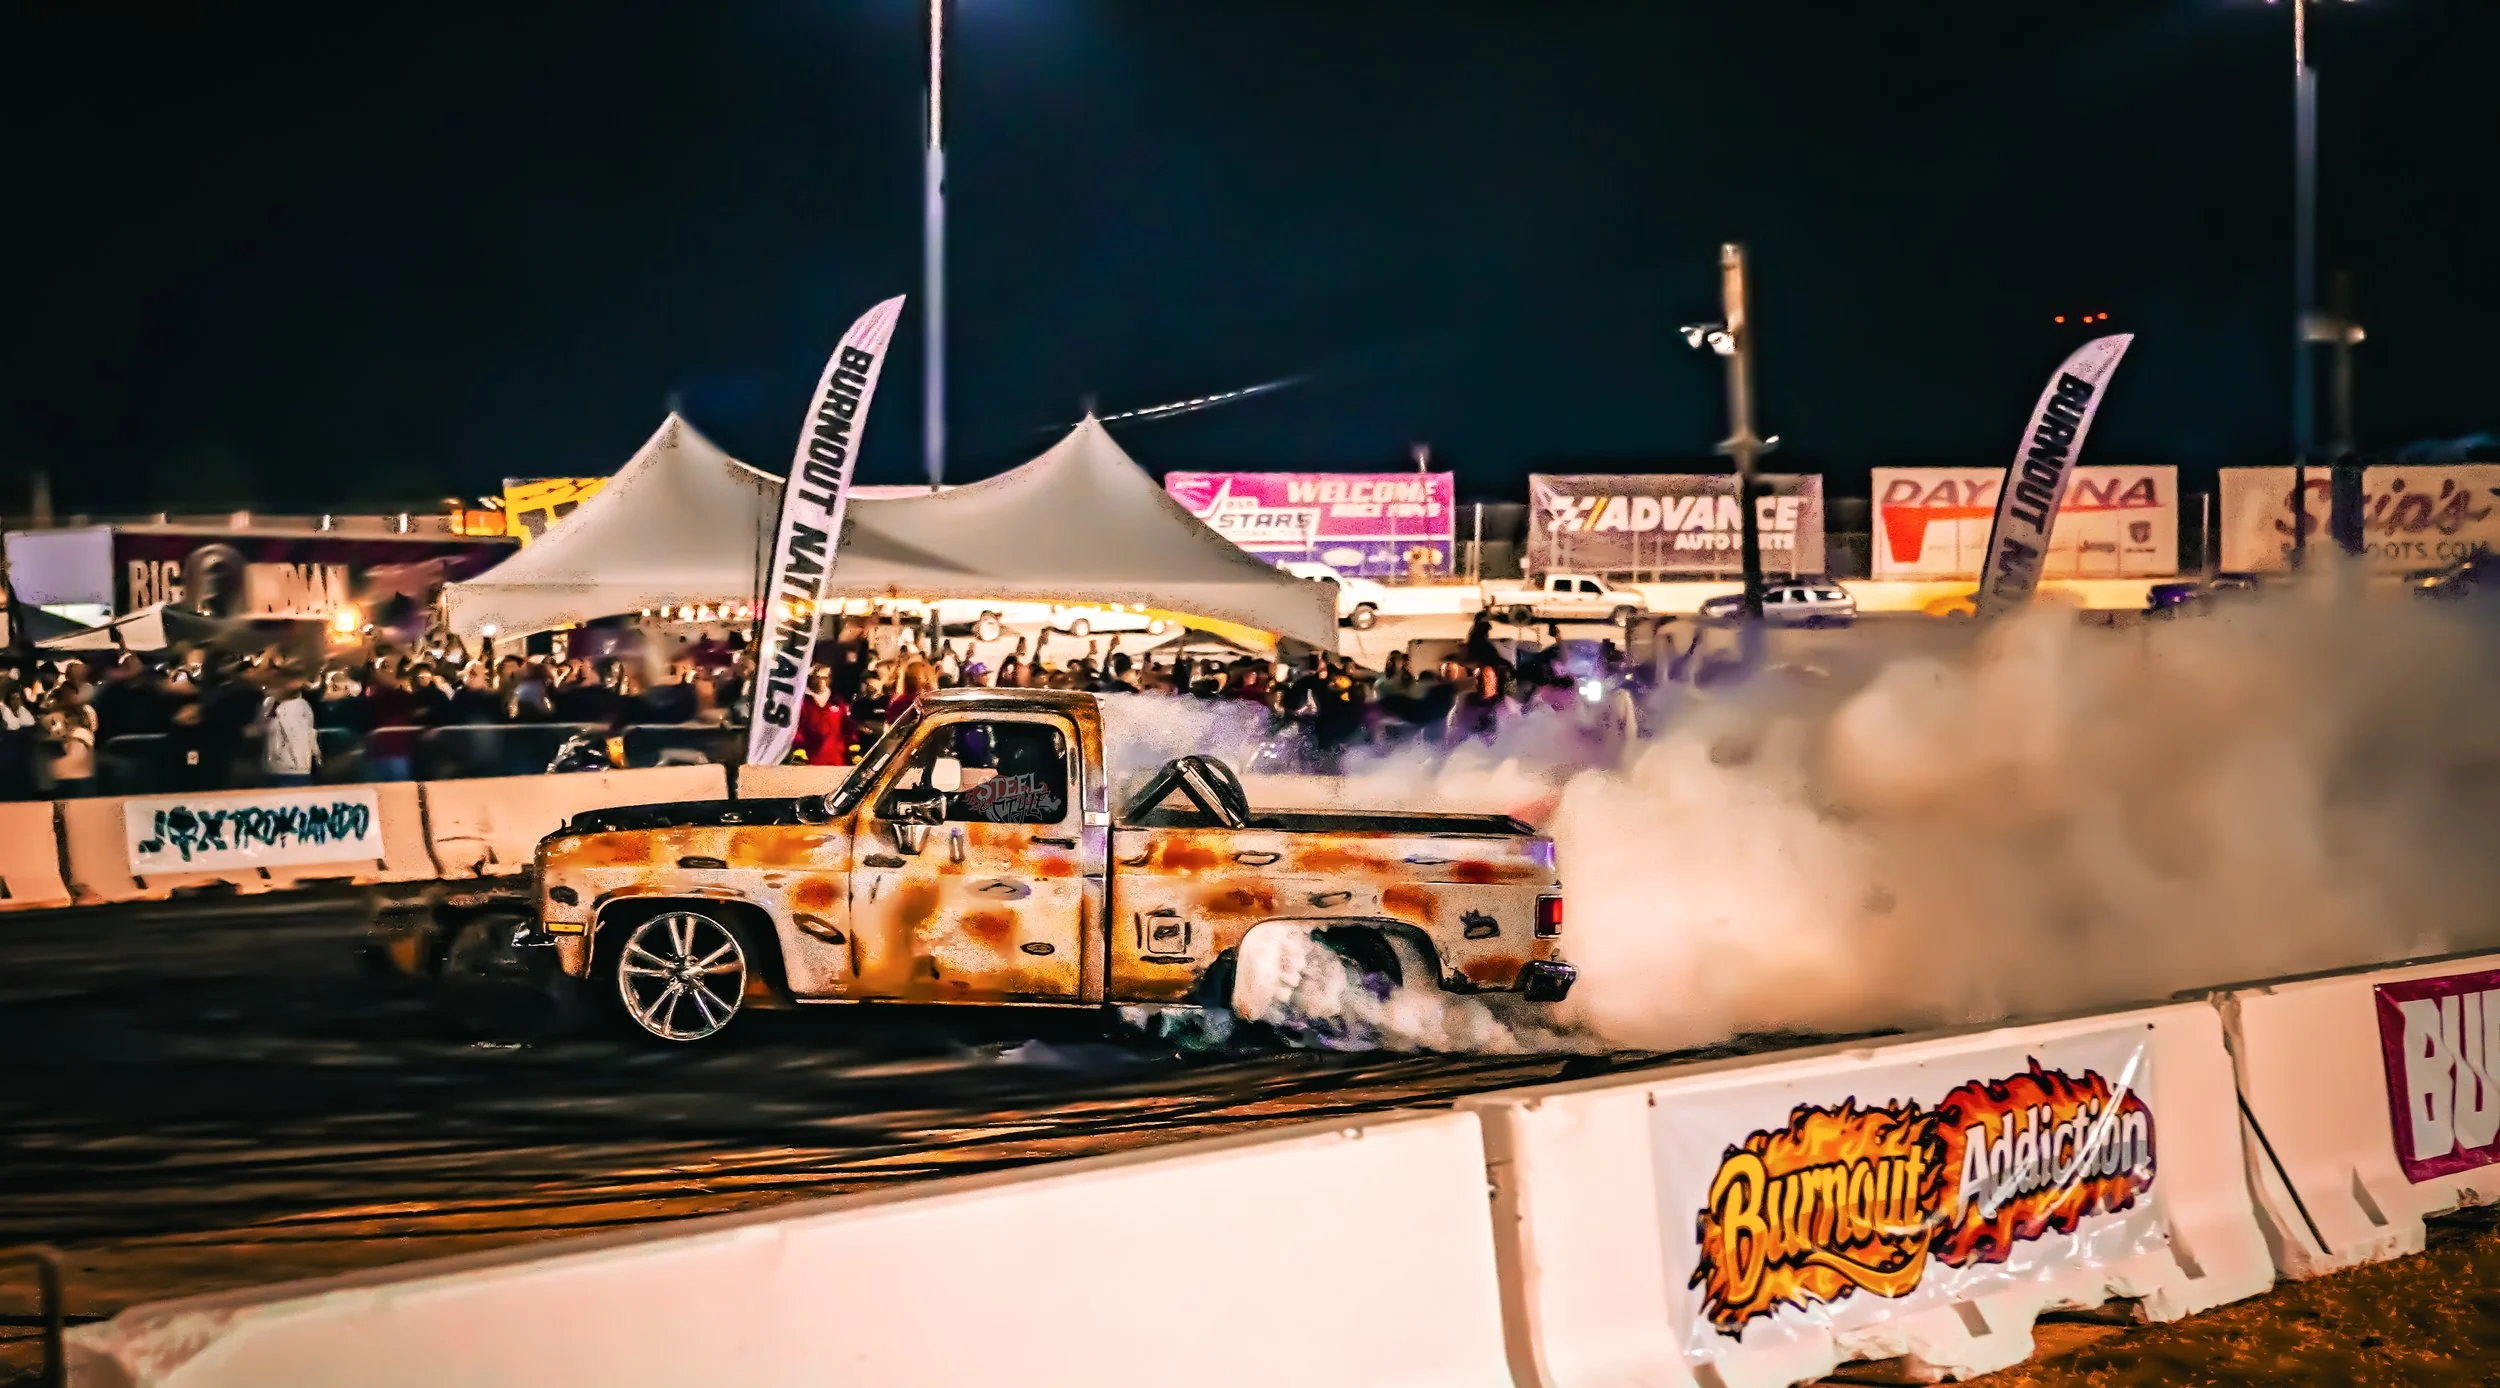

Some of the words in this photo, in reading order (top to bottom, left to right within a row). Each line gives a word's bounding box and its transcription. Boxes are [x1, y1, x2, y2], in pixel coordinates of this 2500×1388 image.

[799, 345, 875, 517] BURNOUT
[2010, 371, 2095, 535] BURNOUT
[1594, 495, 1799, 532] ADVANCE
[1880, 477, 2162, 508] DAYNA
[2274, 477, 2493, 536] Sip's
[1673, 533, 1728, 550] AUTO
[1730, 533, 1795, 550] PRTS
[976, 771, 1044, 804] STEEL
[1709, 1144, 1926, 1304] Burnout
[1952, 1097, 2151, 1230] Addiction
